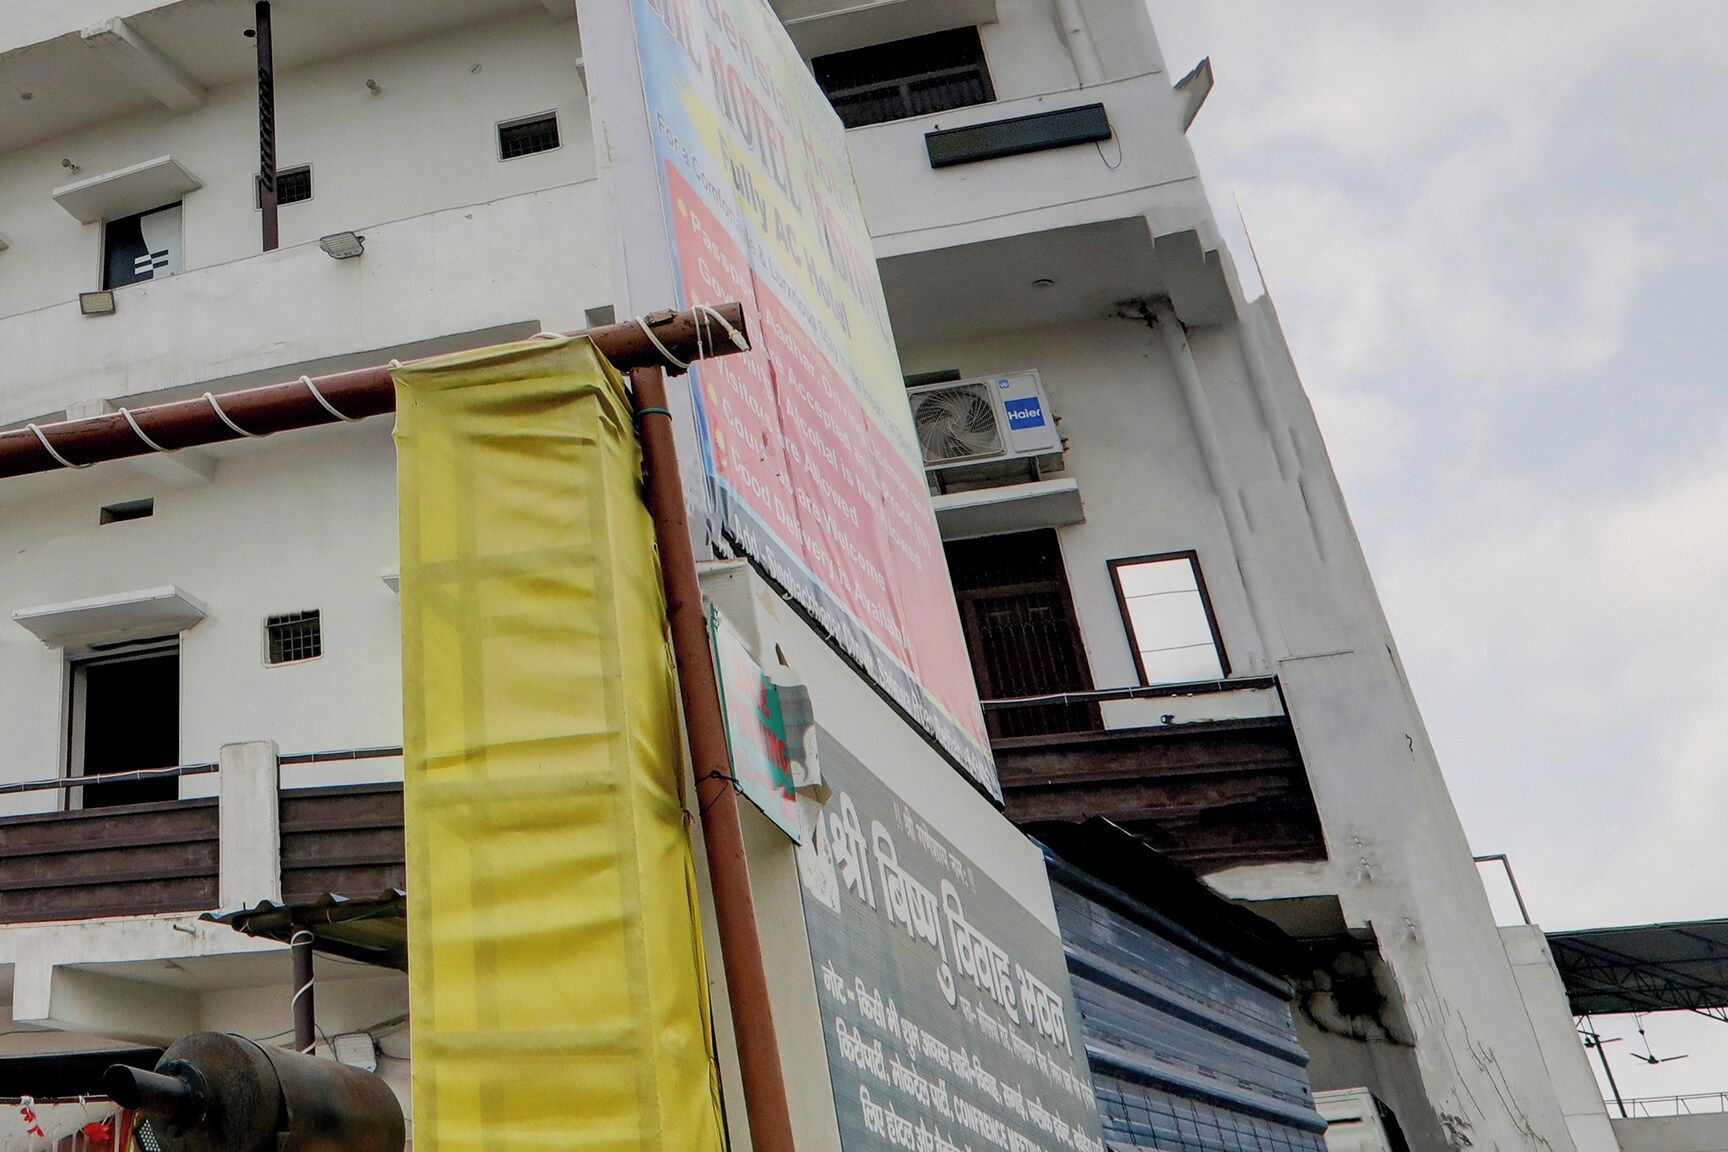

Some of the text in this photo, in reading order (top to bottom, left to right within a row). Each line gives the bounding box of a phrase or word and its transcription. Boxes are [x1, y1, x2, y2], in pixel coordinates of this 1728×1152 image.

[655, 107, 680, 156] For
[702, 23, 804, 221] HOTEL
[717, 129, 769, 234] Fully
[768, 197, 803, 273] AC
[802, 243, 852, 341] Hotel
[1008, 408, 1041, 421] Haier
[800, 448, 859, 530] Allowed
[773, 493, 834, 577] Delivery
[820, 506, 887, 595] Welcome
[830, 791, 876, 910] श्री
[941, 878, 1020, 1025] विवाह
[1015, 963, 1073, 1058] भवन
[854, 977, 887, 1030] किसी
[886, 998, 902, 1040] भी
[900, 1017, 923, 1061] शुभ
[921, 1030, 953, 1071] अवसर
[859, 1084, 886, 1139] लिए
[884, 1100, 916, 1152] होटल
